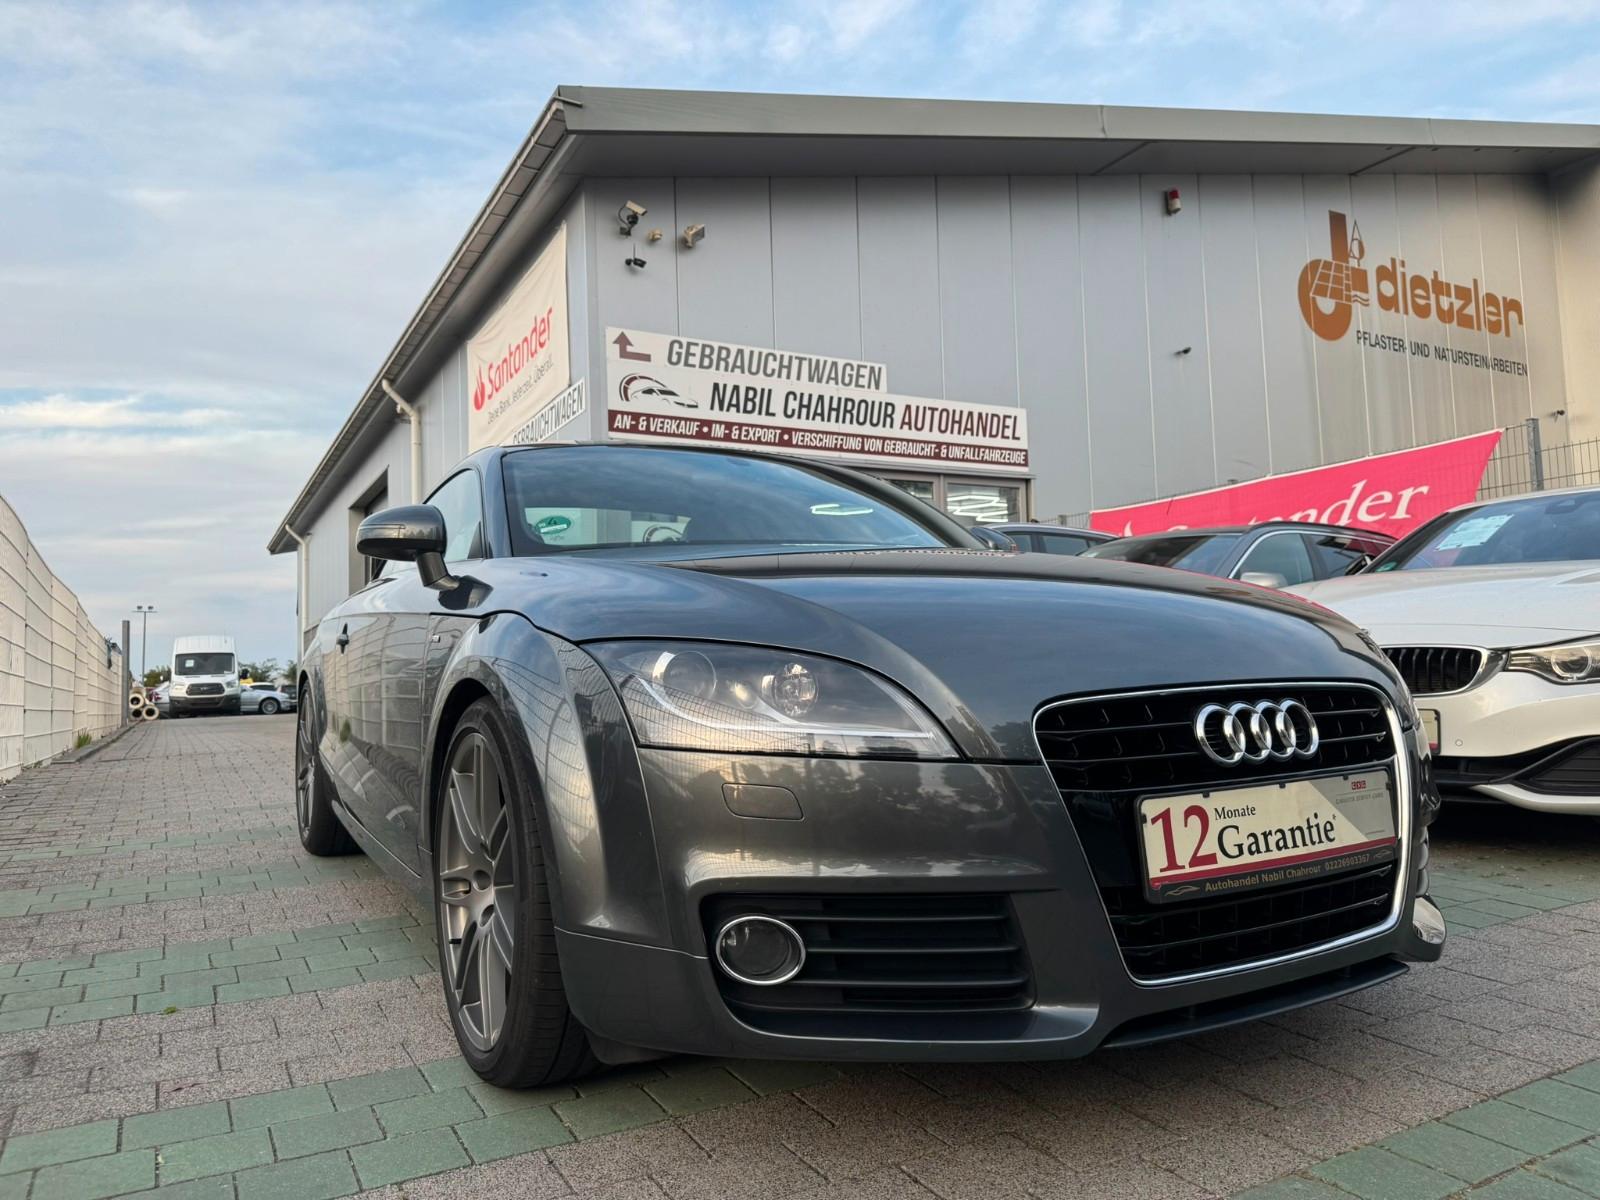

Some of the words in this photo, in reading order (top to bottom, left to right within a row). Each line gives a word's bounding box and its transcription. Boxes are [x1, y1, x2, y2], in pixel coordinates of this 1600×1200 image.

[1375, 256, 1524, 337] dietzler
[487, 307, 553, 401] Santander
[667, 339, 882, 391] GEBRAUCHTWAGEN
[1356, 330, 1408, 353] PFLASTER-
[1410, 342, 1430, 359] UND
[1434, 346, 1528, 377] NATURSTEINARBEITEN
[709, 382, 776, 417] NABIL
[783, 391, 896, 429] CHAHROUR
[900, 404, 1021, 441] AUTOHANDEL
[614, 414, 636, 430] AN-
[638, 416, 647, 431] &
[650, 417, 700, 436] VERKAUF
[711, 424, 729, 439] IM-
[732, 426, 740, 441] &
[741, 426, 781, 443] EXPORT
[792, 431, 862, 450] VERSCHIFFUNG
[864, 438, 882, 452] VON
[884, 440, 939, 457] GEBRAUCHT-
[941, 446, 947, 457] &
[949, 446, 1027, 465] UNFALLFAHRZEUGE
[1150, 805, 1218, 873] 12
[1214, 804, 1256, 821] Monate
[1205, 874, 1260, 892] Autohandel
